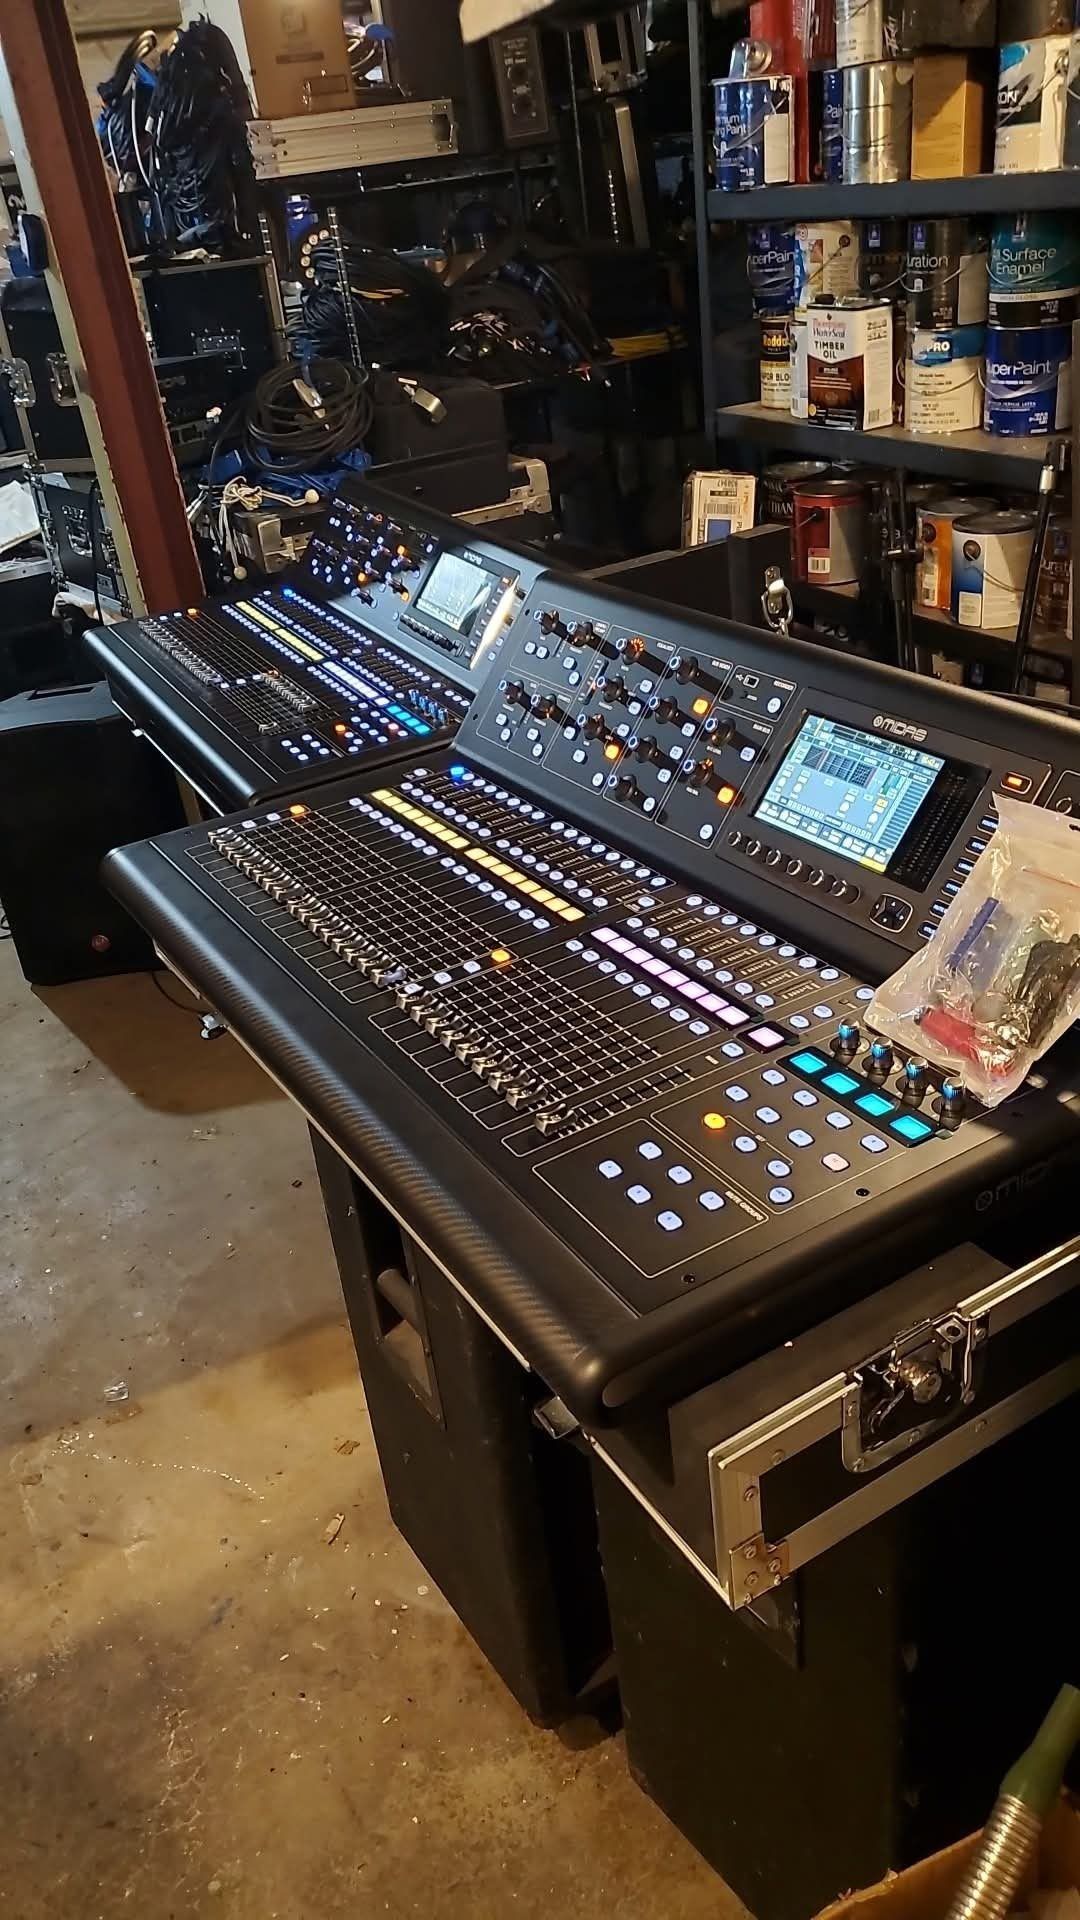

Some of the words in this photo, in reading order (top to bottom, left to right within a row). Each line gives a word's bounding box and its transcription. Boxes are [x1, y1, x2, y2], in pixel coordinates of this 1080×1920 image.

[906, 253, 949, 269] uration
[1002, 247, 1057, 262] Surface
[995, 260, 1046, 275] Enamel
[814, 340, 845, 350] TIMBER
[823, 350, 838, 359] OIL
[991, 360, 1051, 376] perPaint
[776, 372, 791, 382] BLO
[880, 717, 928, 742] MIDAS
